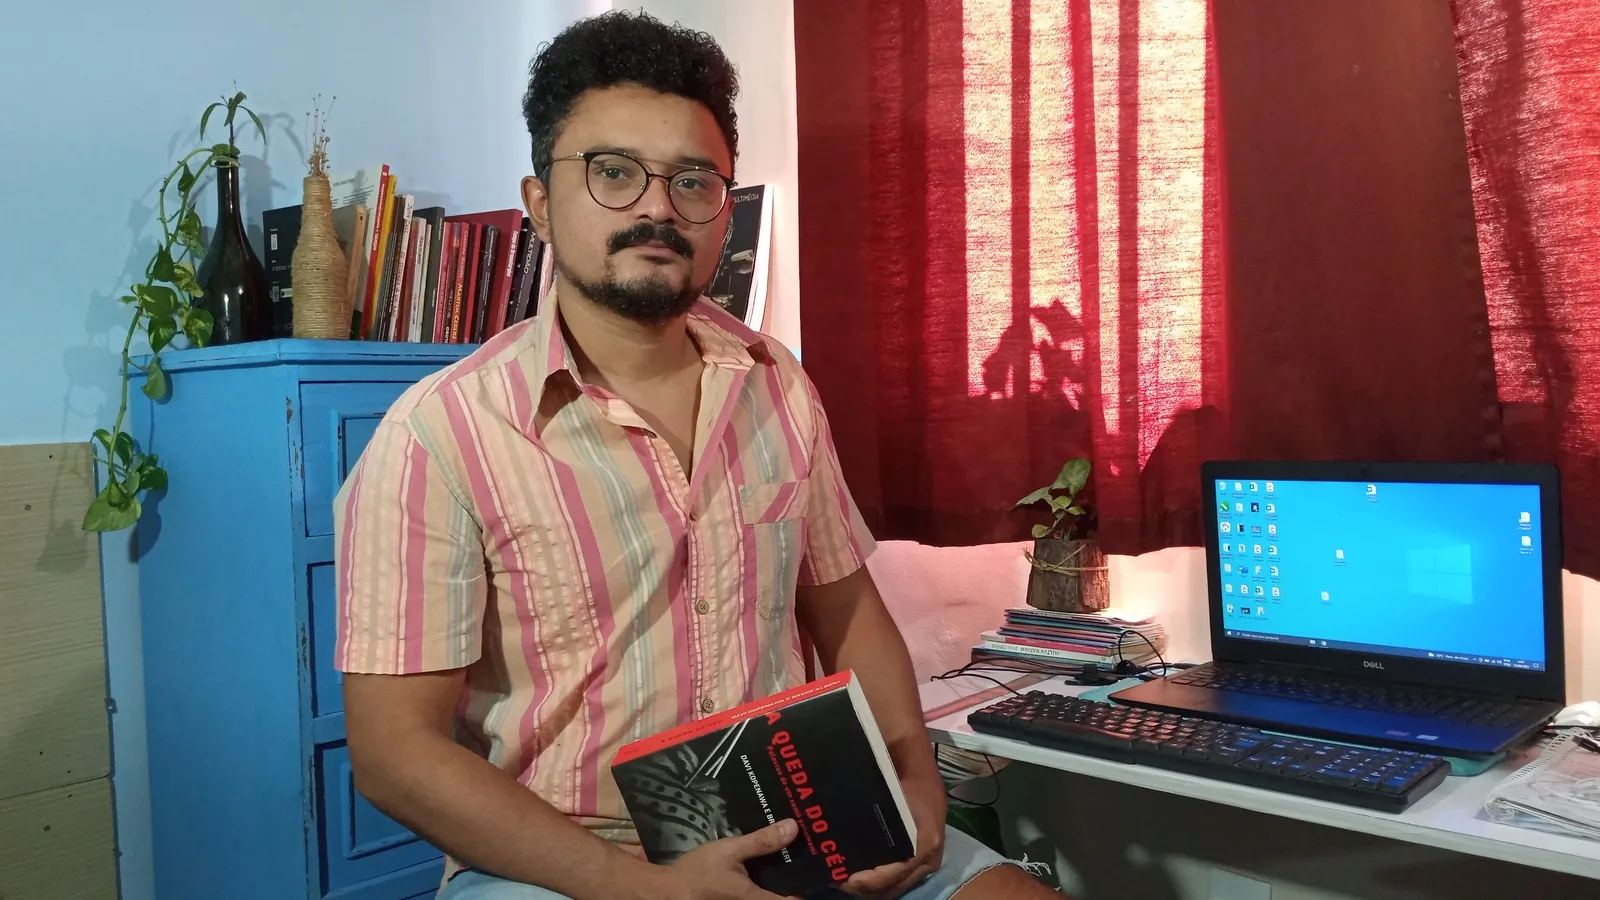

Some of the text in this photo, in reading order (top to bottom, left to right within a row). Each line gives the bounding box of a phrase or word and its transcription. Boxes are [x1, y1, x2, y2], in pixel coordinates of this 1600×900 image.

[734, 193, 759, 203] ULTIMÉDIA
[523, 231, 536, 274] MULTIDÃO
[1363, 660, 1385, 670] DELL
[791, 688, 815, 700] BRUCE
[814, 680, 842, 692] ALBERT
[740, 754, 752, 772] DAVI
[747, 770, 769, 809] KOPENAWA
[764, 807, 772, 816] E
[767, 745, 783, 776] Palavras
[780, 776, 788, 786] de
[784, 786, 793, 798] um
[764, 711, 849, 881] A QUEDA DO CÉU
